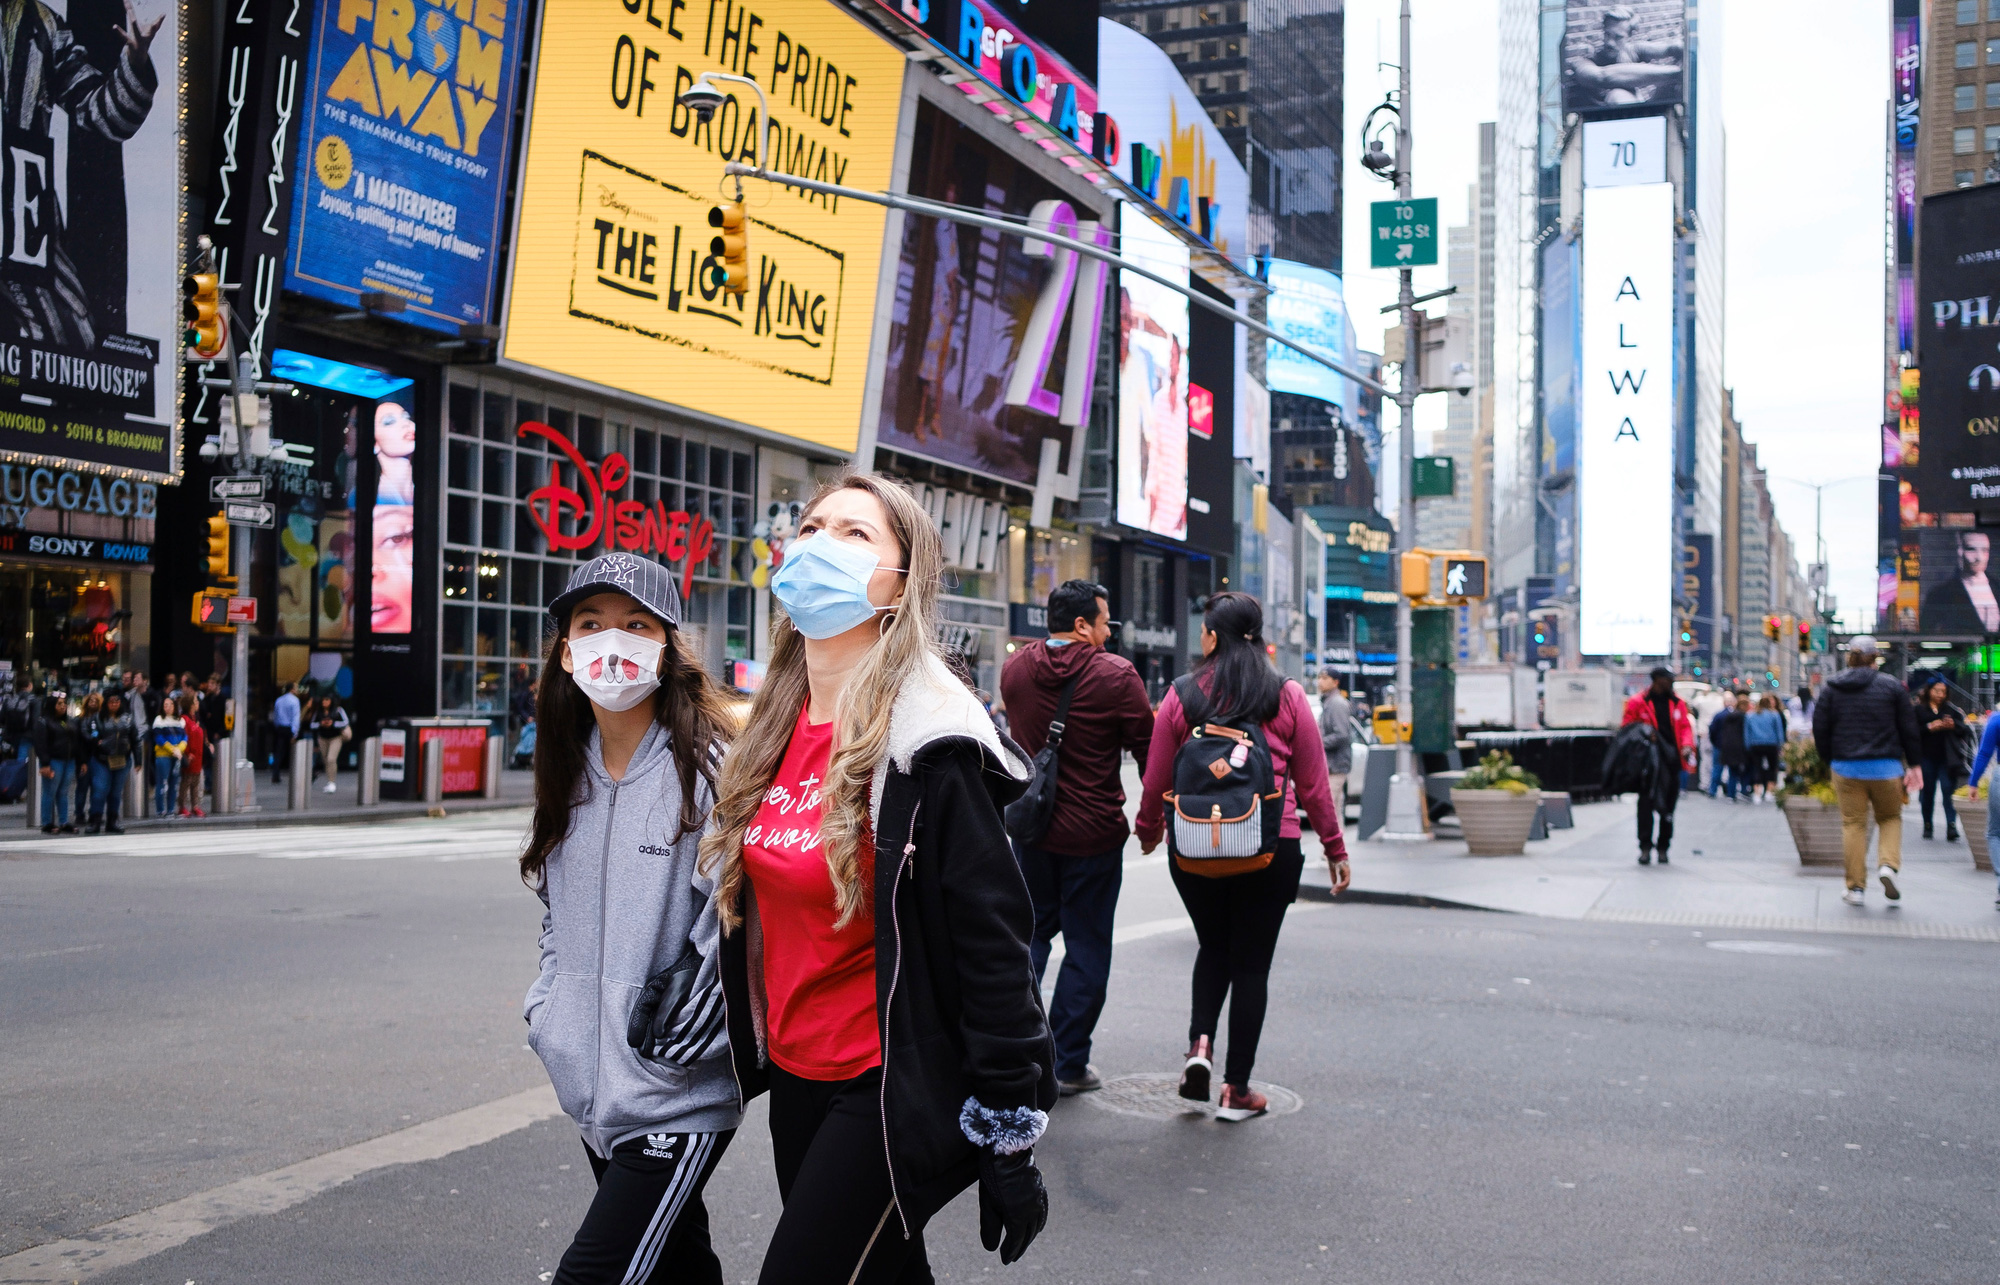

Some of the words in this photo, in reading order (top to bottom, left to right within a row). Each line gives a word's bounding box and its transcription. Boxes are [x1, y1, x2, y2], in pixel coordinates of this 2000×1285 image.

[611, 34, 661, 118] OF
[704, 0, 764, 82] THE
[771, 30, 857, 138] PRIDE
[326, 42, 498, 157] AWAY
[323, 103, 347, 122] THE
[349, 112, 425, 153] REMARKABLE
[425, 144, 454, 167] TRUE
[454, 156, 488, 178] STORY
[1610, 141, 1635, 168] 70
[317, 189, 356, 222] Joyous,
[355, 204, 396, 235] uplifting
[395, 218, 415, 239] and
[413, 223, 443, 251] plenty
[441, 231, 452, 251] of
[367, 175, 457, 232] MASTERPIECE!
[1394, 205, 1414, 221] TO
[1378, 226, 1391, 240] W
[1392, 224, 1413, 240] 45
[1414, 223, 1430, 239] St
[594, 218, 657, 285] THE
[755, 254, 827, 337] KING
[65, 421, 93, 442] 50TH
[95, 427, 105, 444] &
[106, 428, 165, 452] BROADWAY
[1967, 415, 1999, 437] ON
[1, 463, 158, 520] UGGAGE
[29, 535, 95, 557] SONY
[103, 542, 150, 563] BOWER
[594, 555, 640, 584] NY
[796, 772, 823, 814] to
[638, 844, 671, 857] adidas
[642, 1148, 674, 1160] adidas
